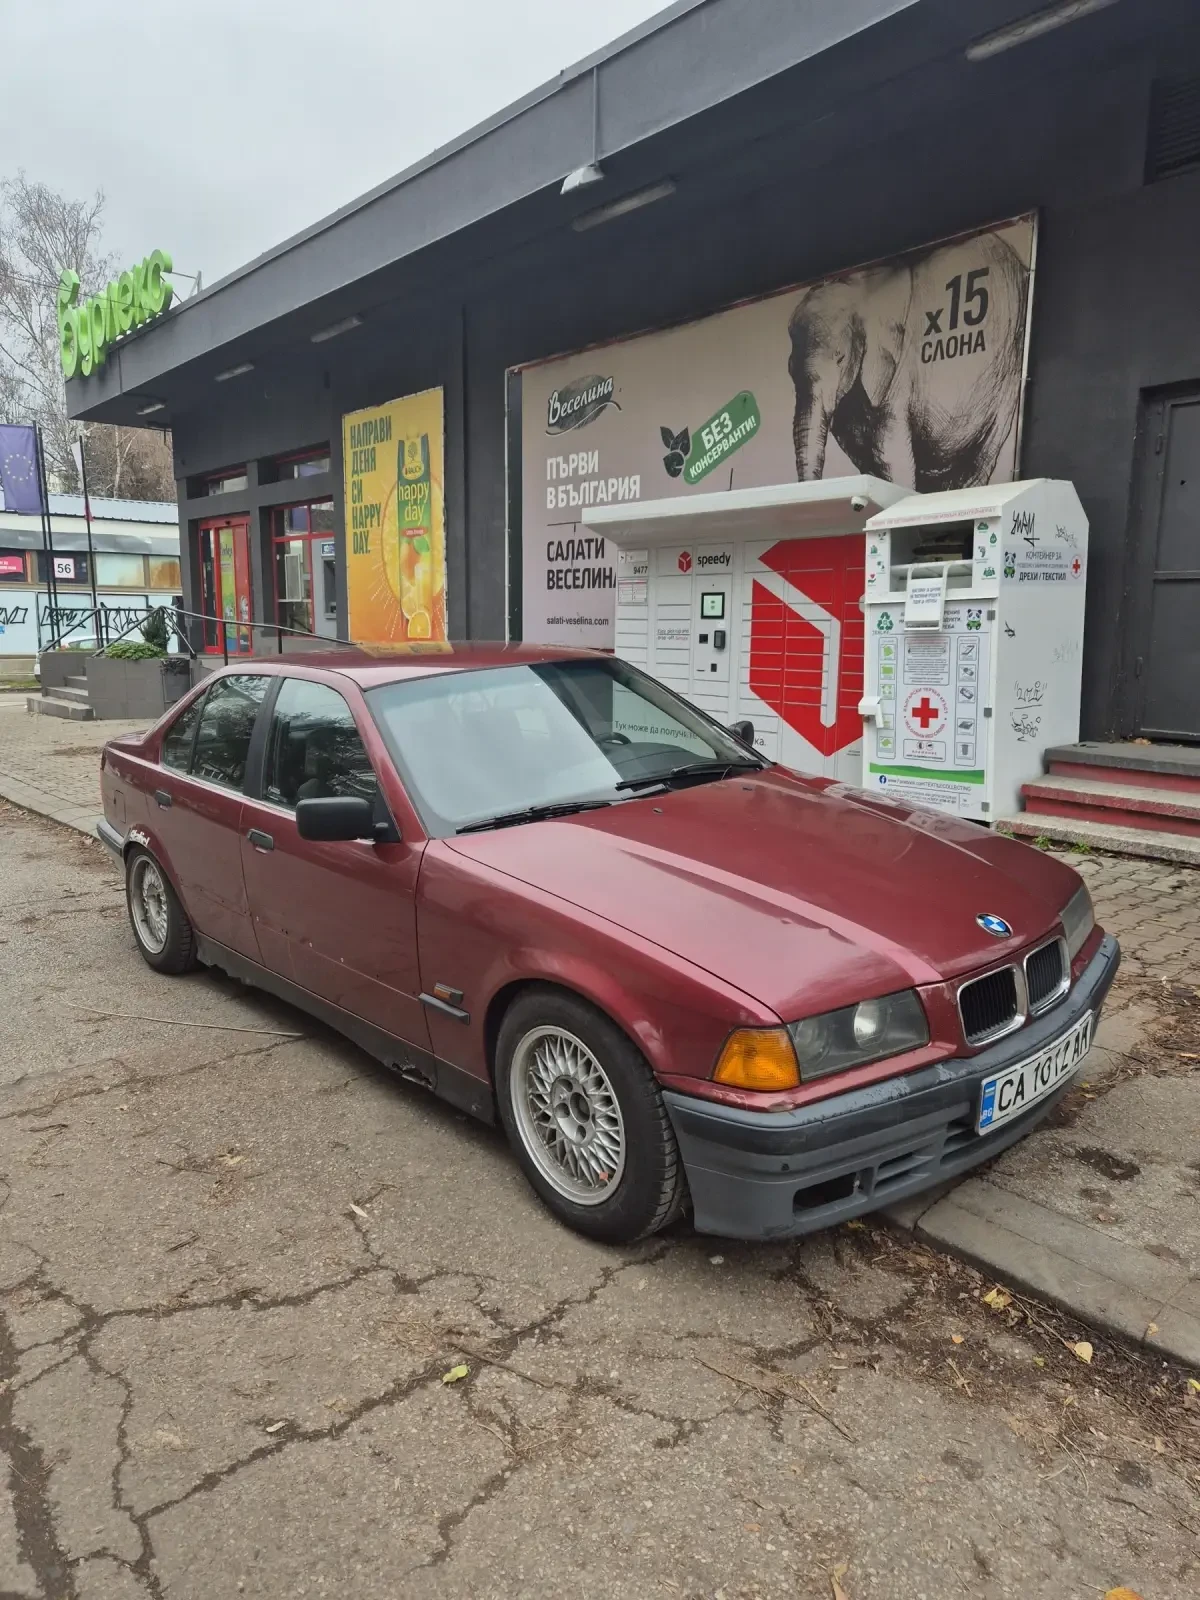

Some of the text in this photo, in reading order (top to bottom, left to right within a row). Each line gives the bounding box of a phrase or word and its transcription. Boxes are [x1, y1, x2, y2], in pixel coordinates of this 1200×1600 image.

[921, 330, 986, 364] СЛОНА
[548, 377, 613, 424] Веселина
[350, 416, 392, 449] НАПРАВИ
[701, 412, 732, 450] БЕЗ
[690, 415, 756, 478] КОНСЕРВАНТИ!
[352, 447, 376, 478] ДЕНЯ
[547, 449, 599, 480] ПЪРВИ
[351, 479, 363, 504] СИ
[398, 481, 430, 505] happy
[547, 475, 640, 509] В БЪЛГАРИЯ
[352, 503, 382, 529] HAPPY
[404, 503, 425, 525] day
[353, 531, 371, 555] DAY.
[547, 537, 605, 562] САЛАТИ
[57, 563, 72, 574] 56
[633, 566, 648, 574] 9477
[698, 552, 731, 568] speedy
[1019, 572, 1038, 582] ДРЕХИ
[1042, 572, 1066, 580] ТЕКСТИЛ
[546, 616, 609, 625] salati-veselina.com
[615, 720, 627, 732] Тук
[628, 725, 648, 733] може
[650, 726, 659, 735] да
[998, 1072, 1024, 1112] CA
